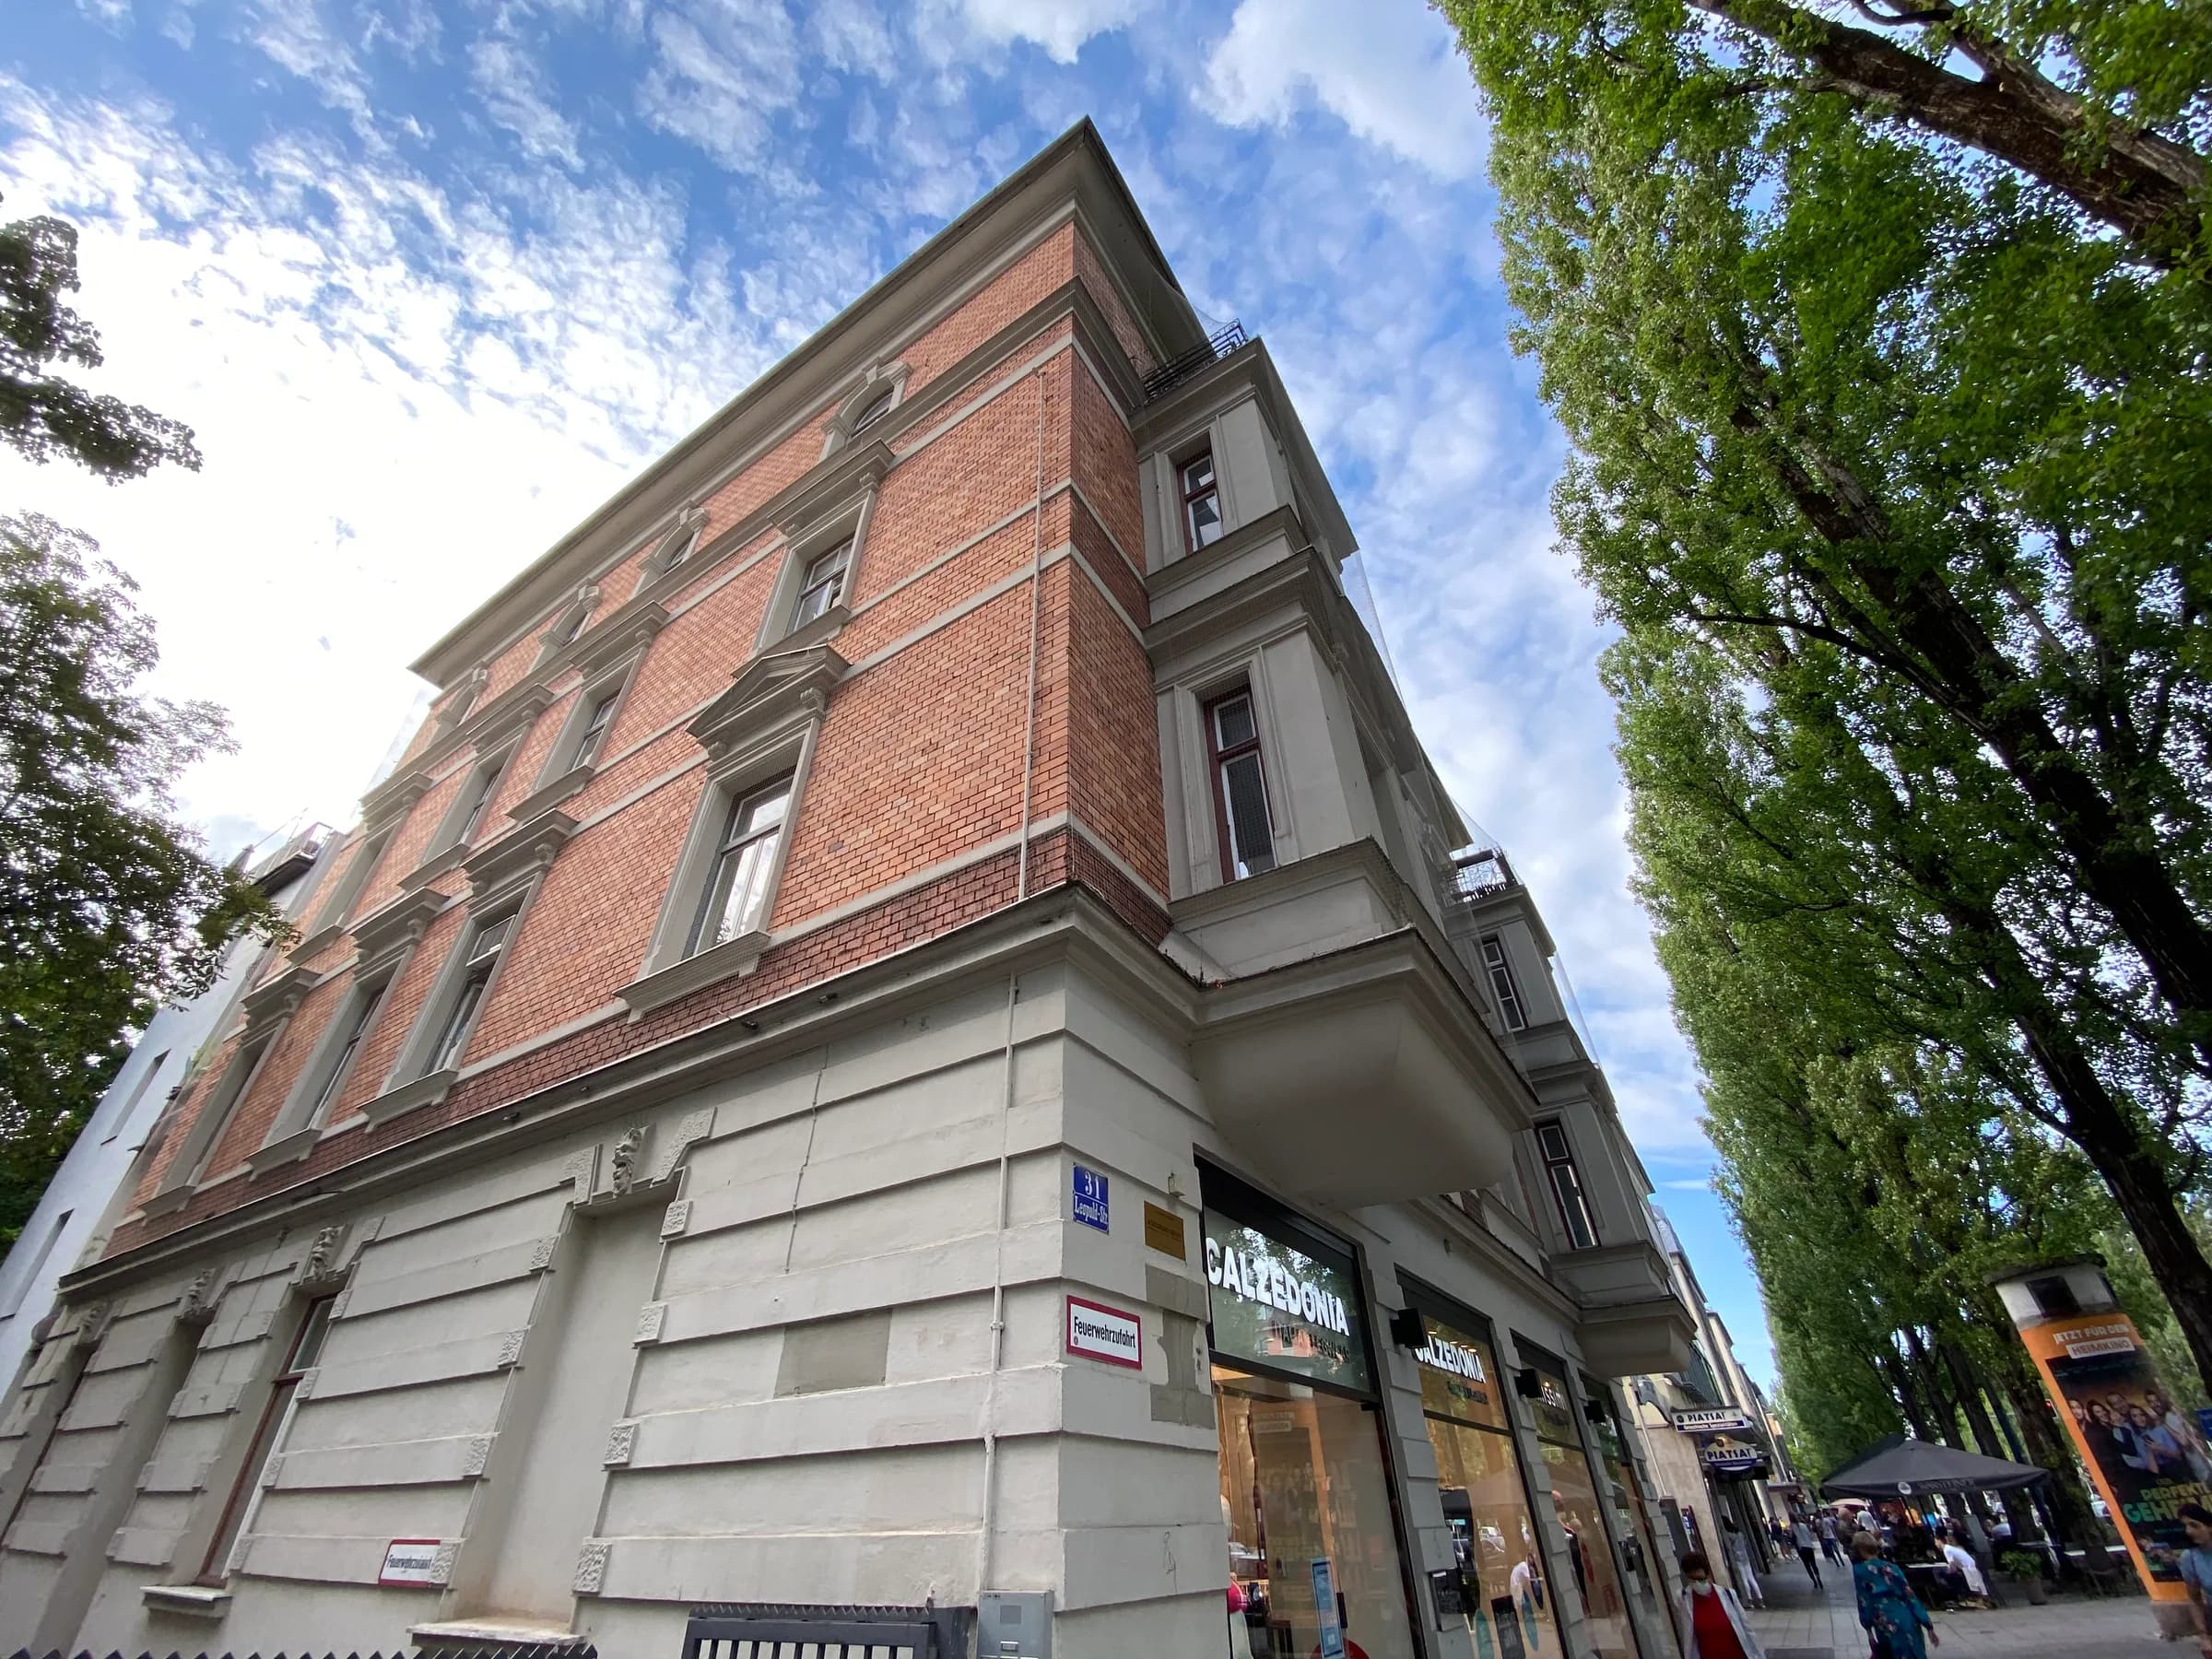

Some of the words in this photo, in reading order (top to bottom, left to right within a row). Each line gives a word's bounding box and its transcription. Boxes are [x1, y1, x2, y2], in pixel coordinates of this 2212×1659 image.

[1084, 1171, 1101, 1200] 31
[1206, 1237, 1350, 1336] CALZEDONIA
[1074, 1315, 1136, 1348] Feuerwehrzufahrt
